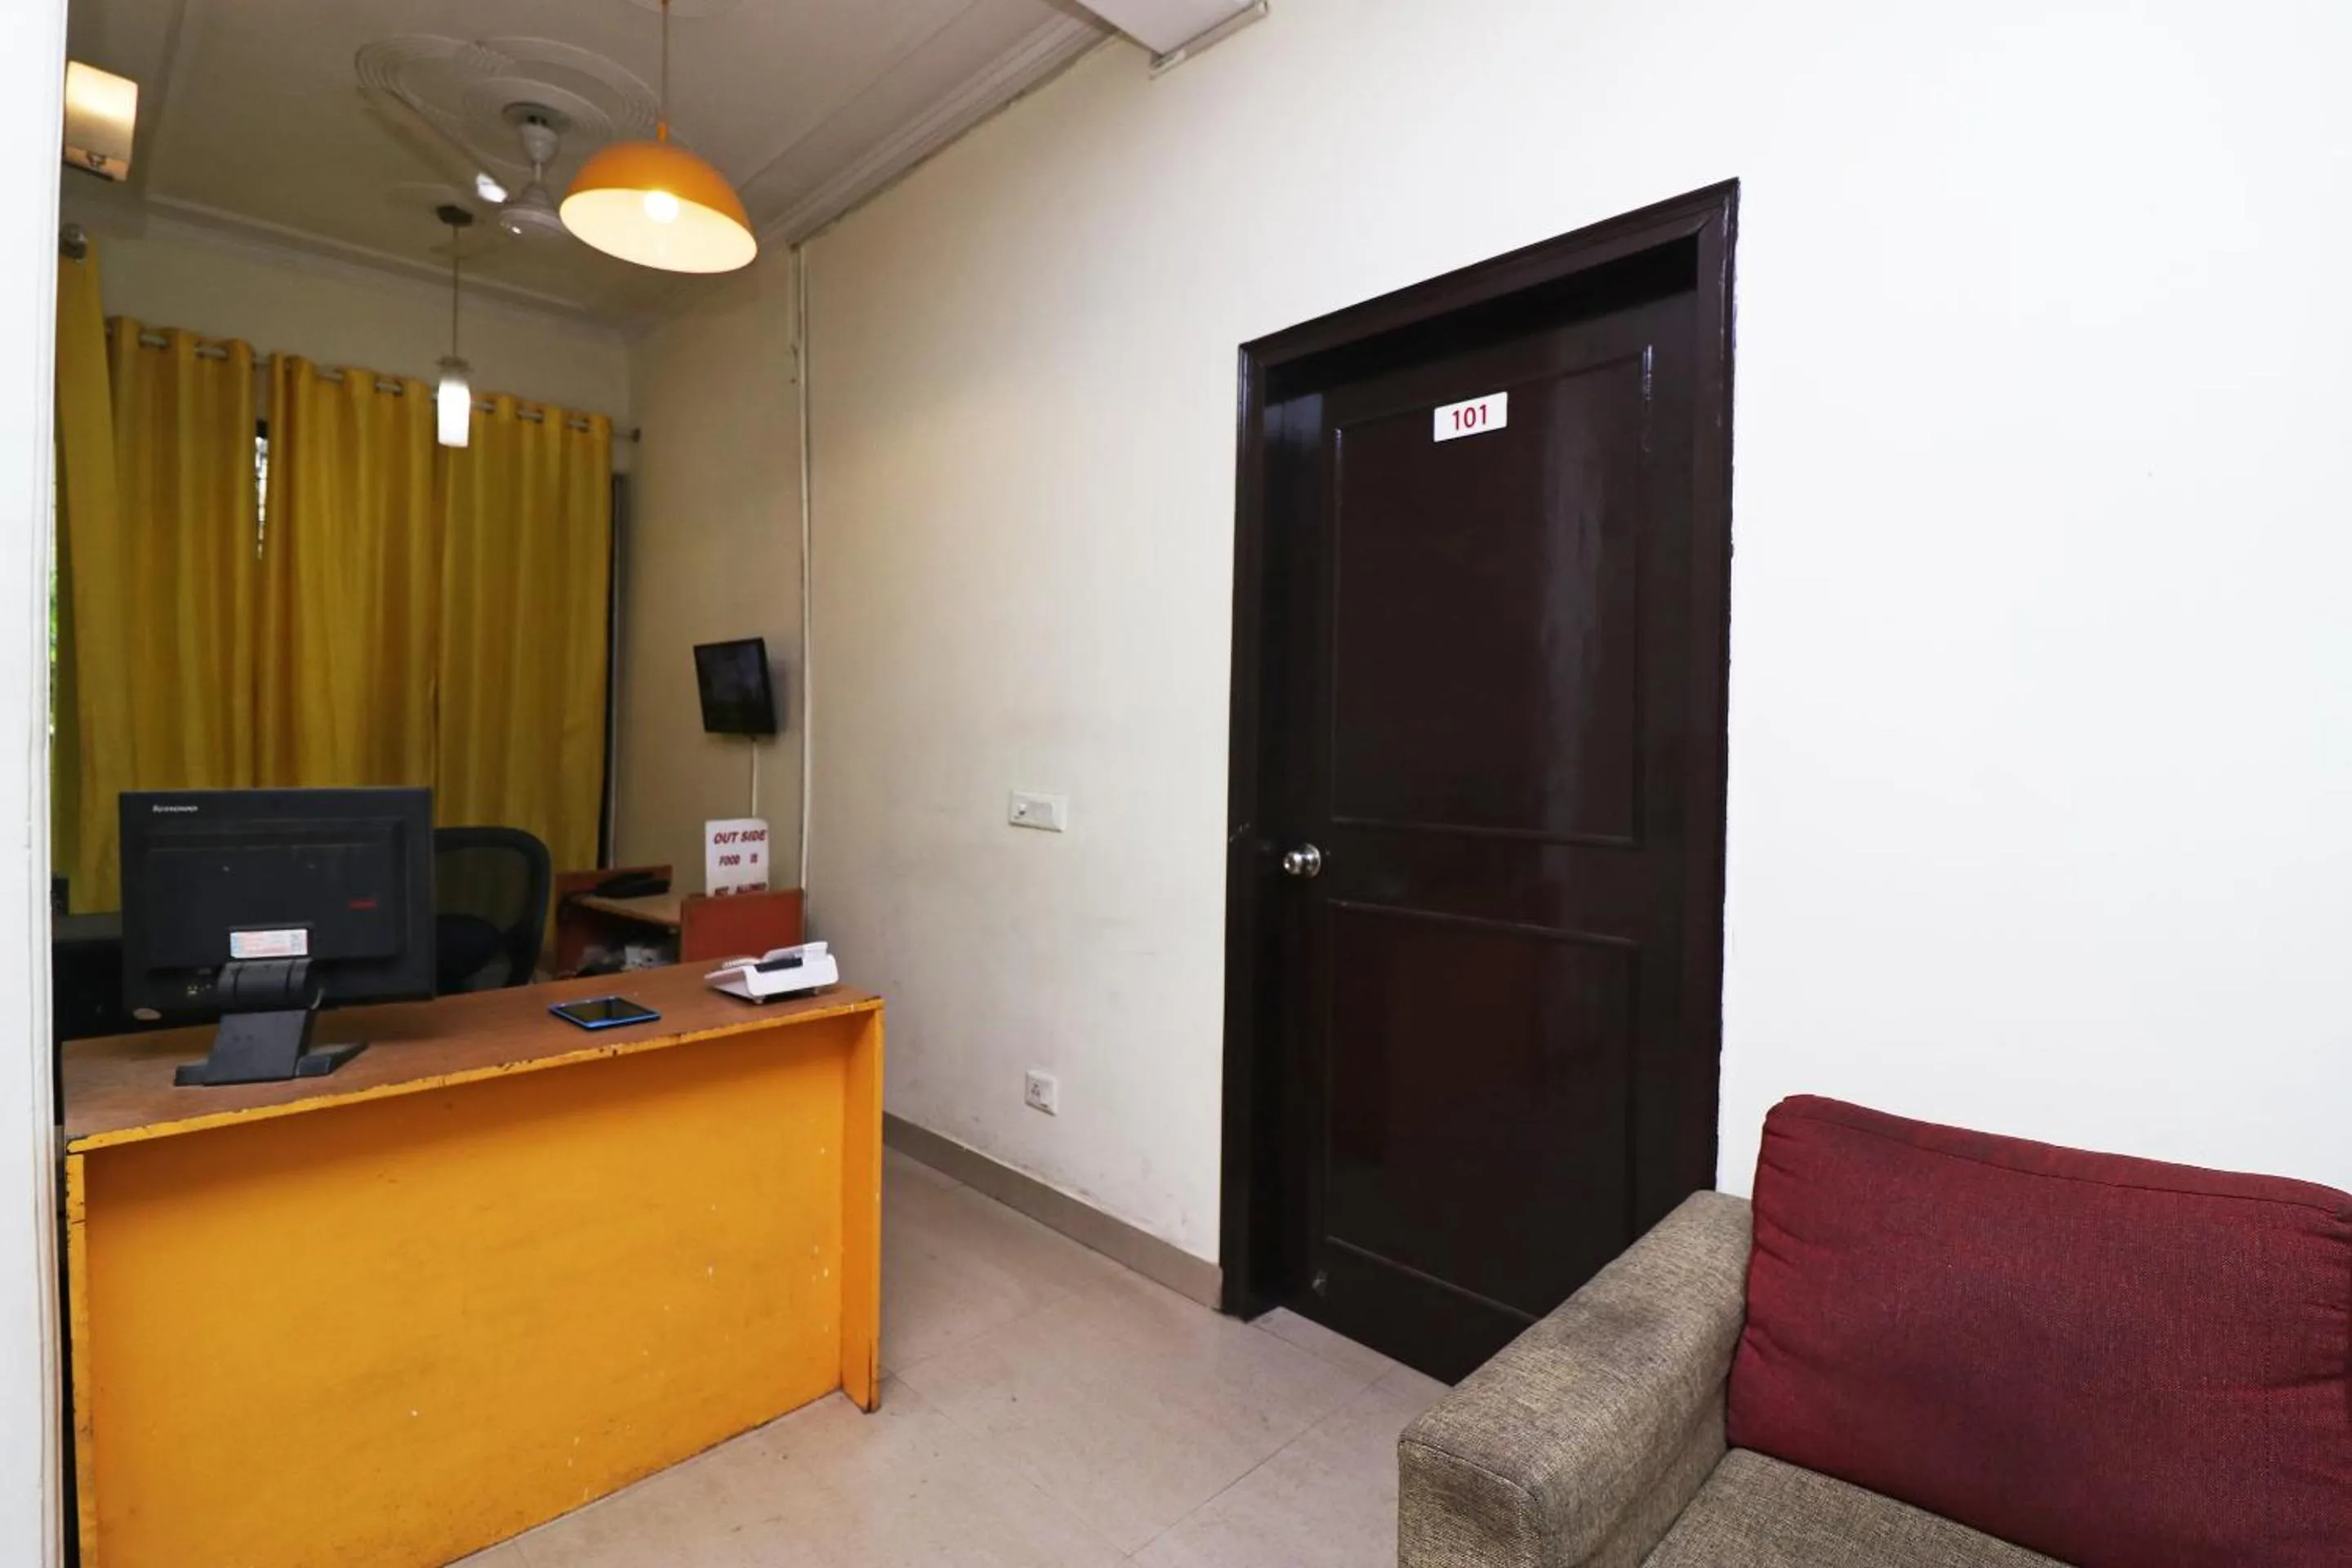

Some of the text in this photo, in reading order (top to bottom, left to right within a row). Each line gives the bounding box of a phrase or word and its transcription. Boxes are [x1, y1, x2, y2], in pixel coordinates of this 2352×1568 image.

[1453, 404, 1486, 430] 101
[714, 830, 766, 844] OUT SIDE
[719, 853, 758, 866] FOOD IS
